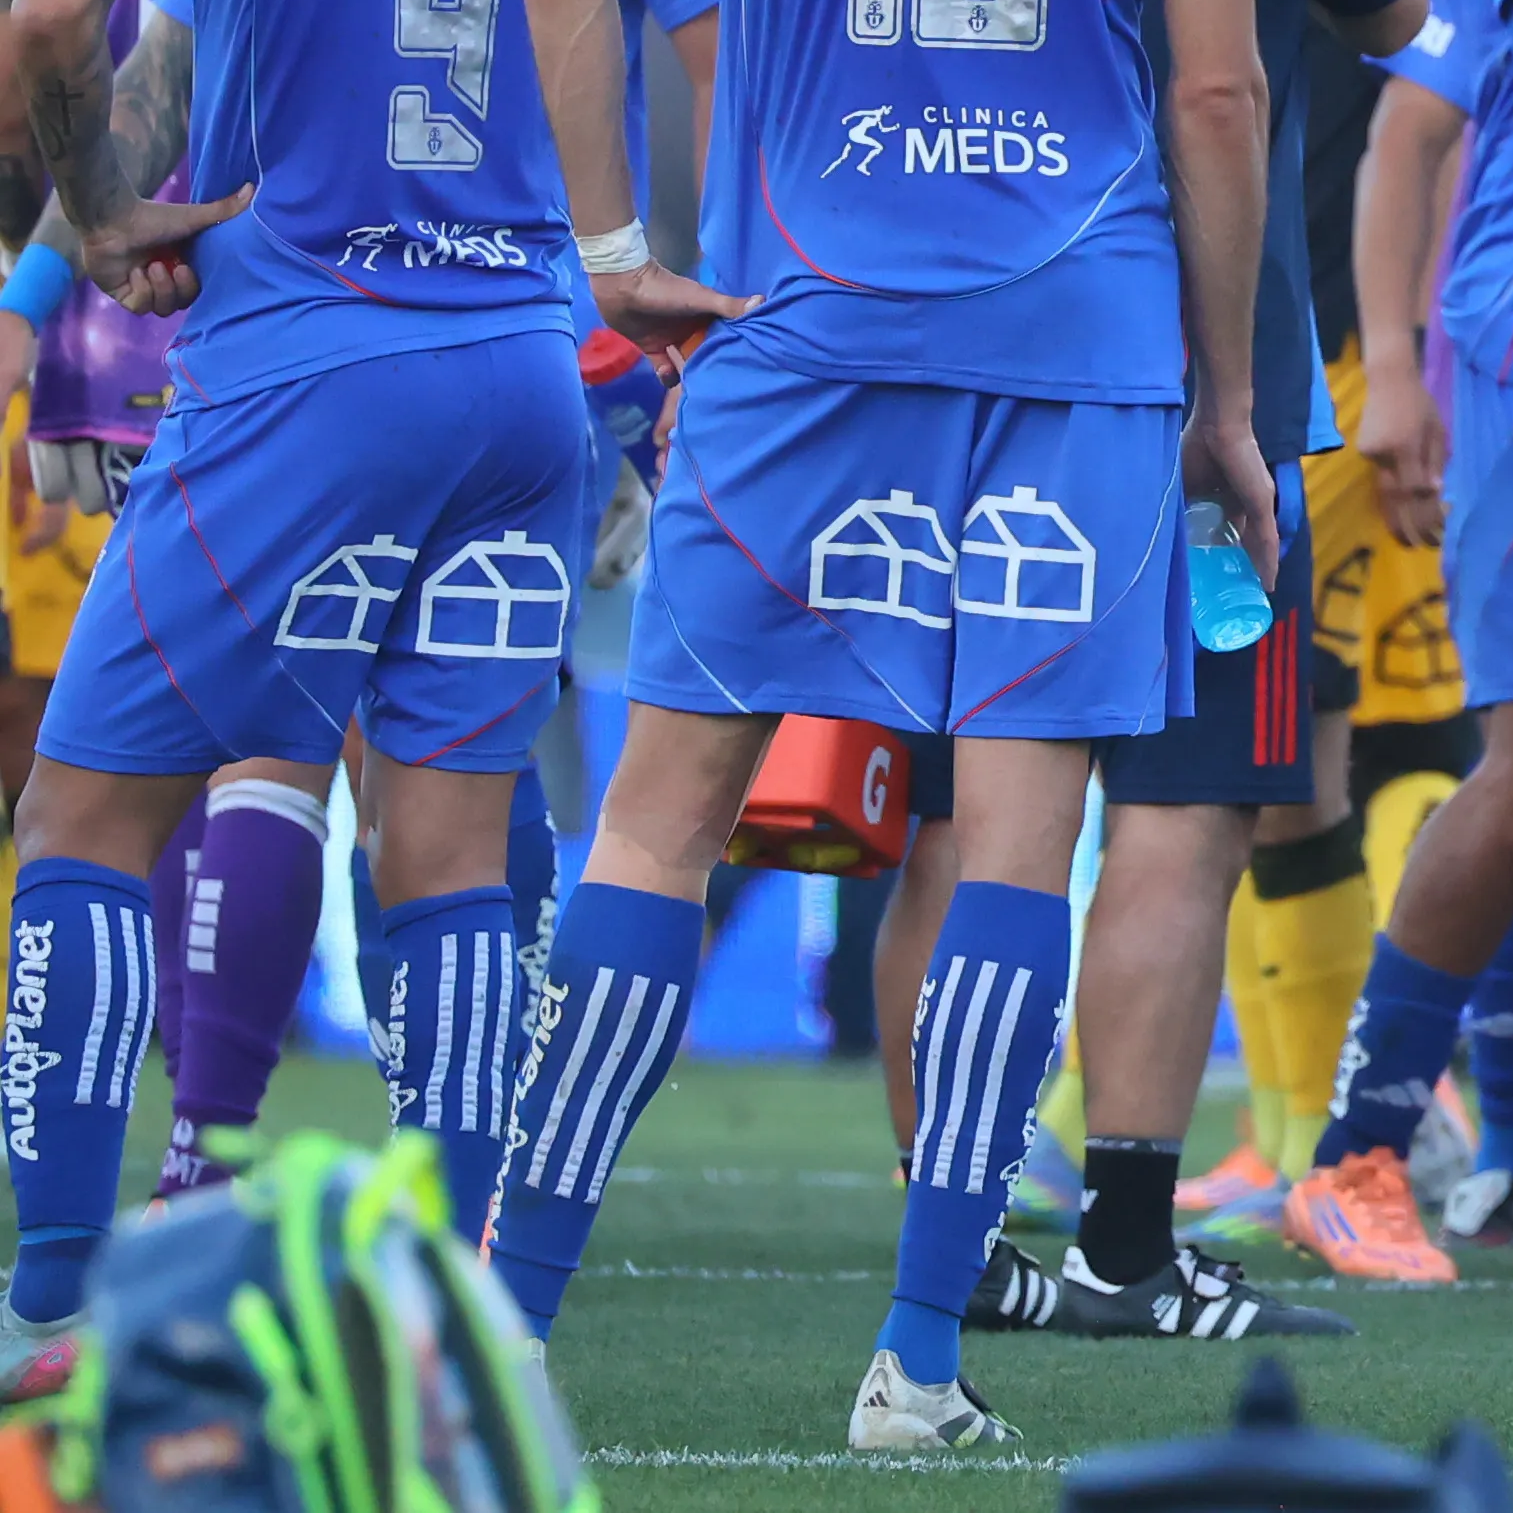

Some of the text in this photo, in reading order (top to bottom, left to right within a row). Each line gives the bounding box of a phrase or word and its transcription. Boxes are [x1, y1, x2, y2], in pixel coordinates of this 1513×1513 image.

[922, 105, 1050, 129] CLINICA
[903, 127, 1070, 177] MEDS
[862, 745, 893, 825] G
[4, 919, 62, 1162] AutoPlanet
